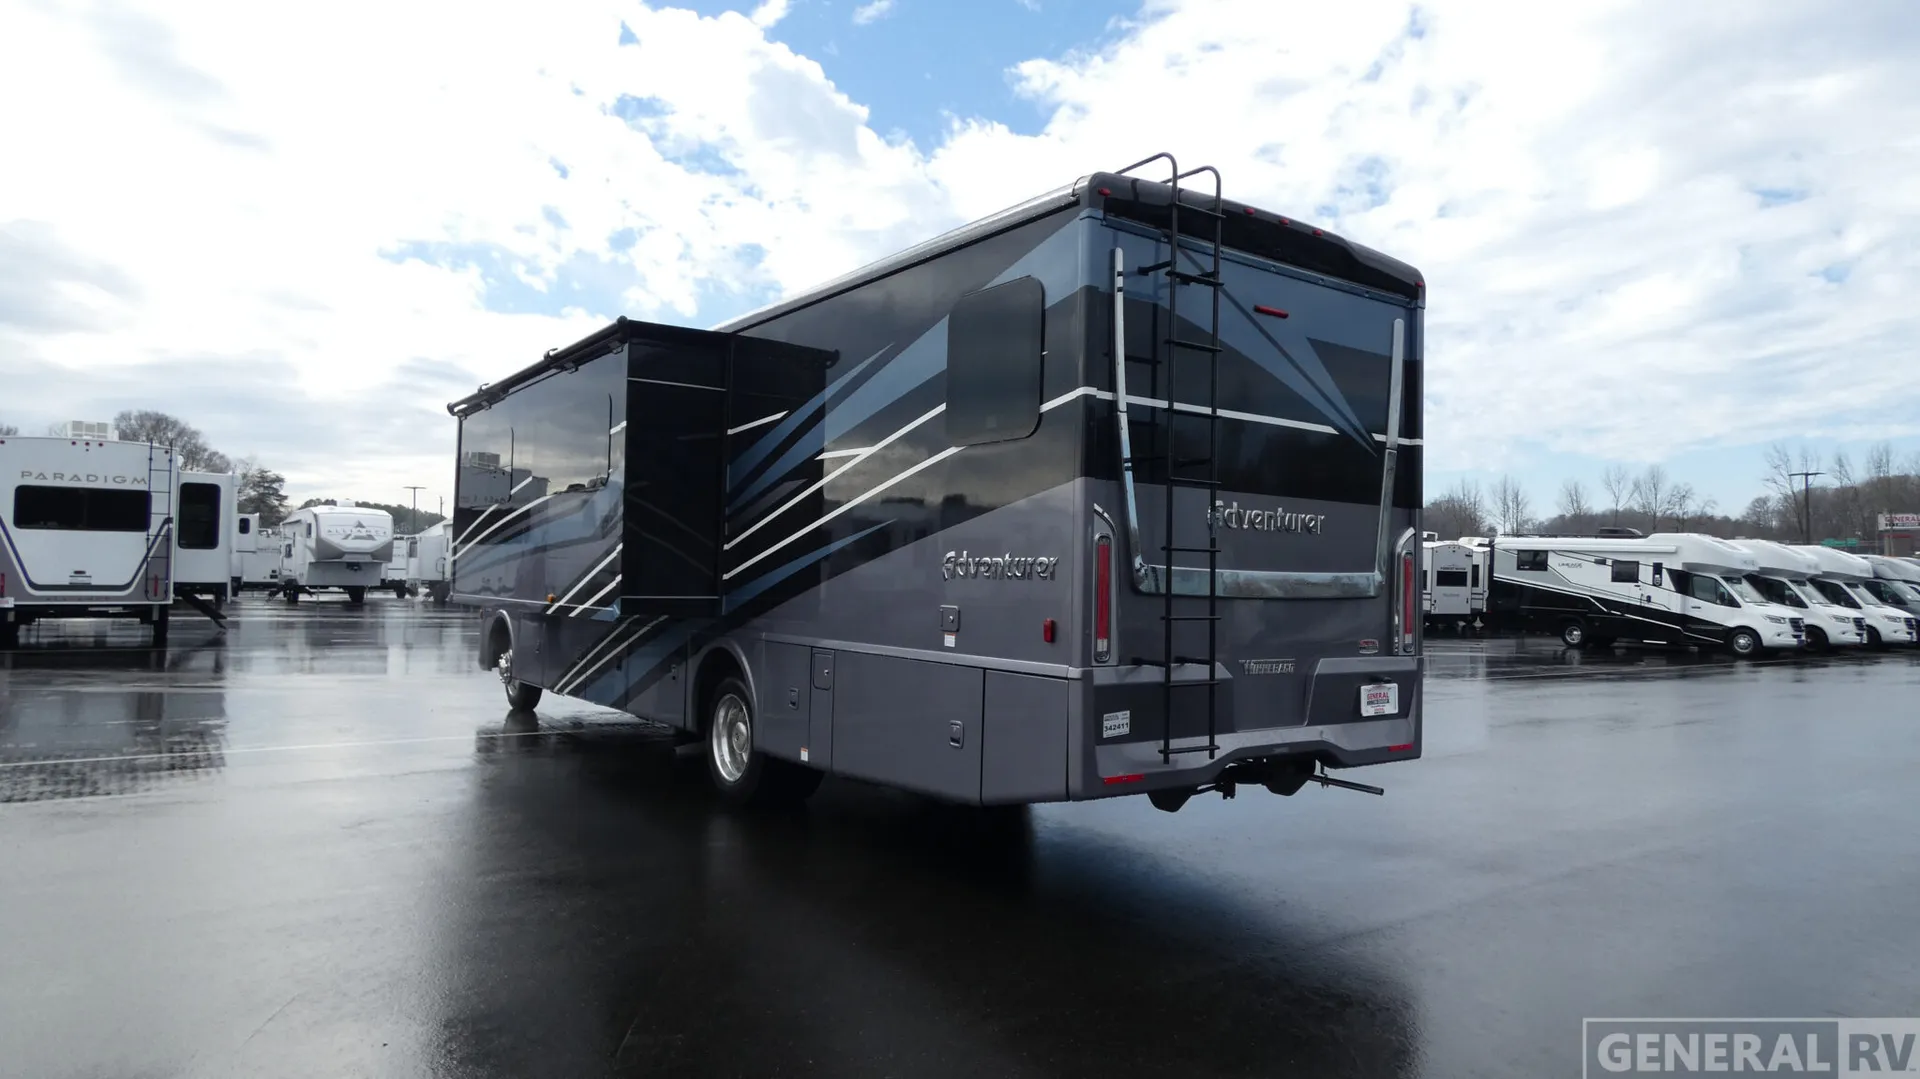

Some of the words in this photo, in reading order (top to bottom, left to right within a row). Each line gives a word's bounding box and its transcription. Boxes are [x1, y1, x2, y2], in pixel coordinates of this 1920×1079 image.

[20, 470, 148, 485] PARADIGM
[1206, 499, 1325, 535] Adventurer
[942, 550, 1059, 581] Adventurer
[1104, 722, 1129, 732] 342411
